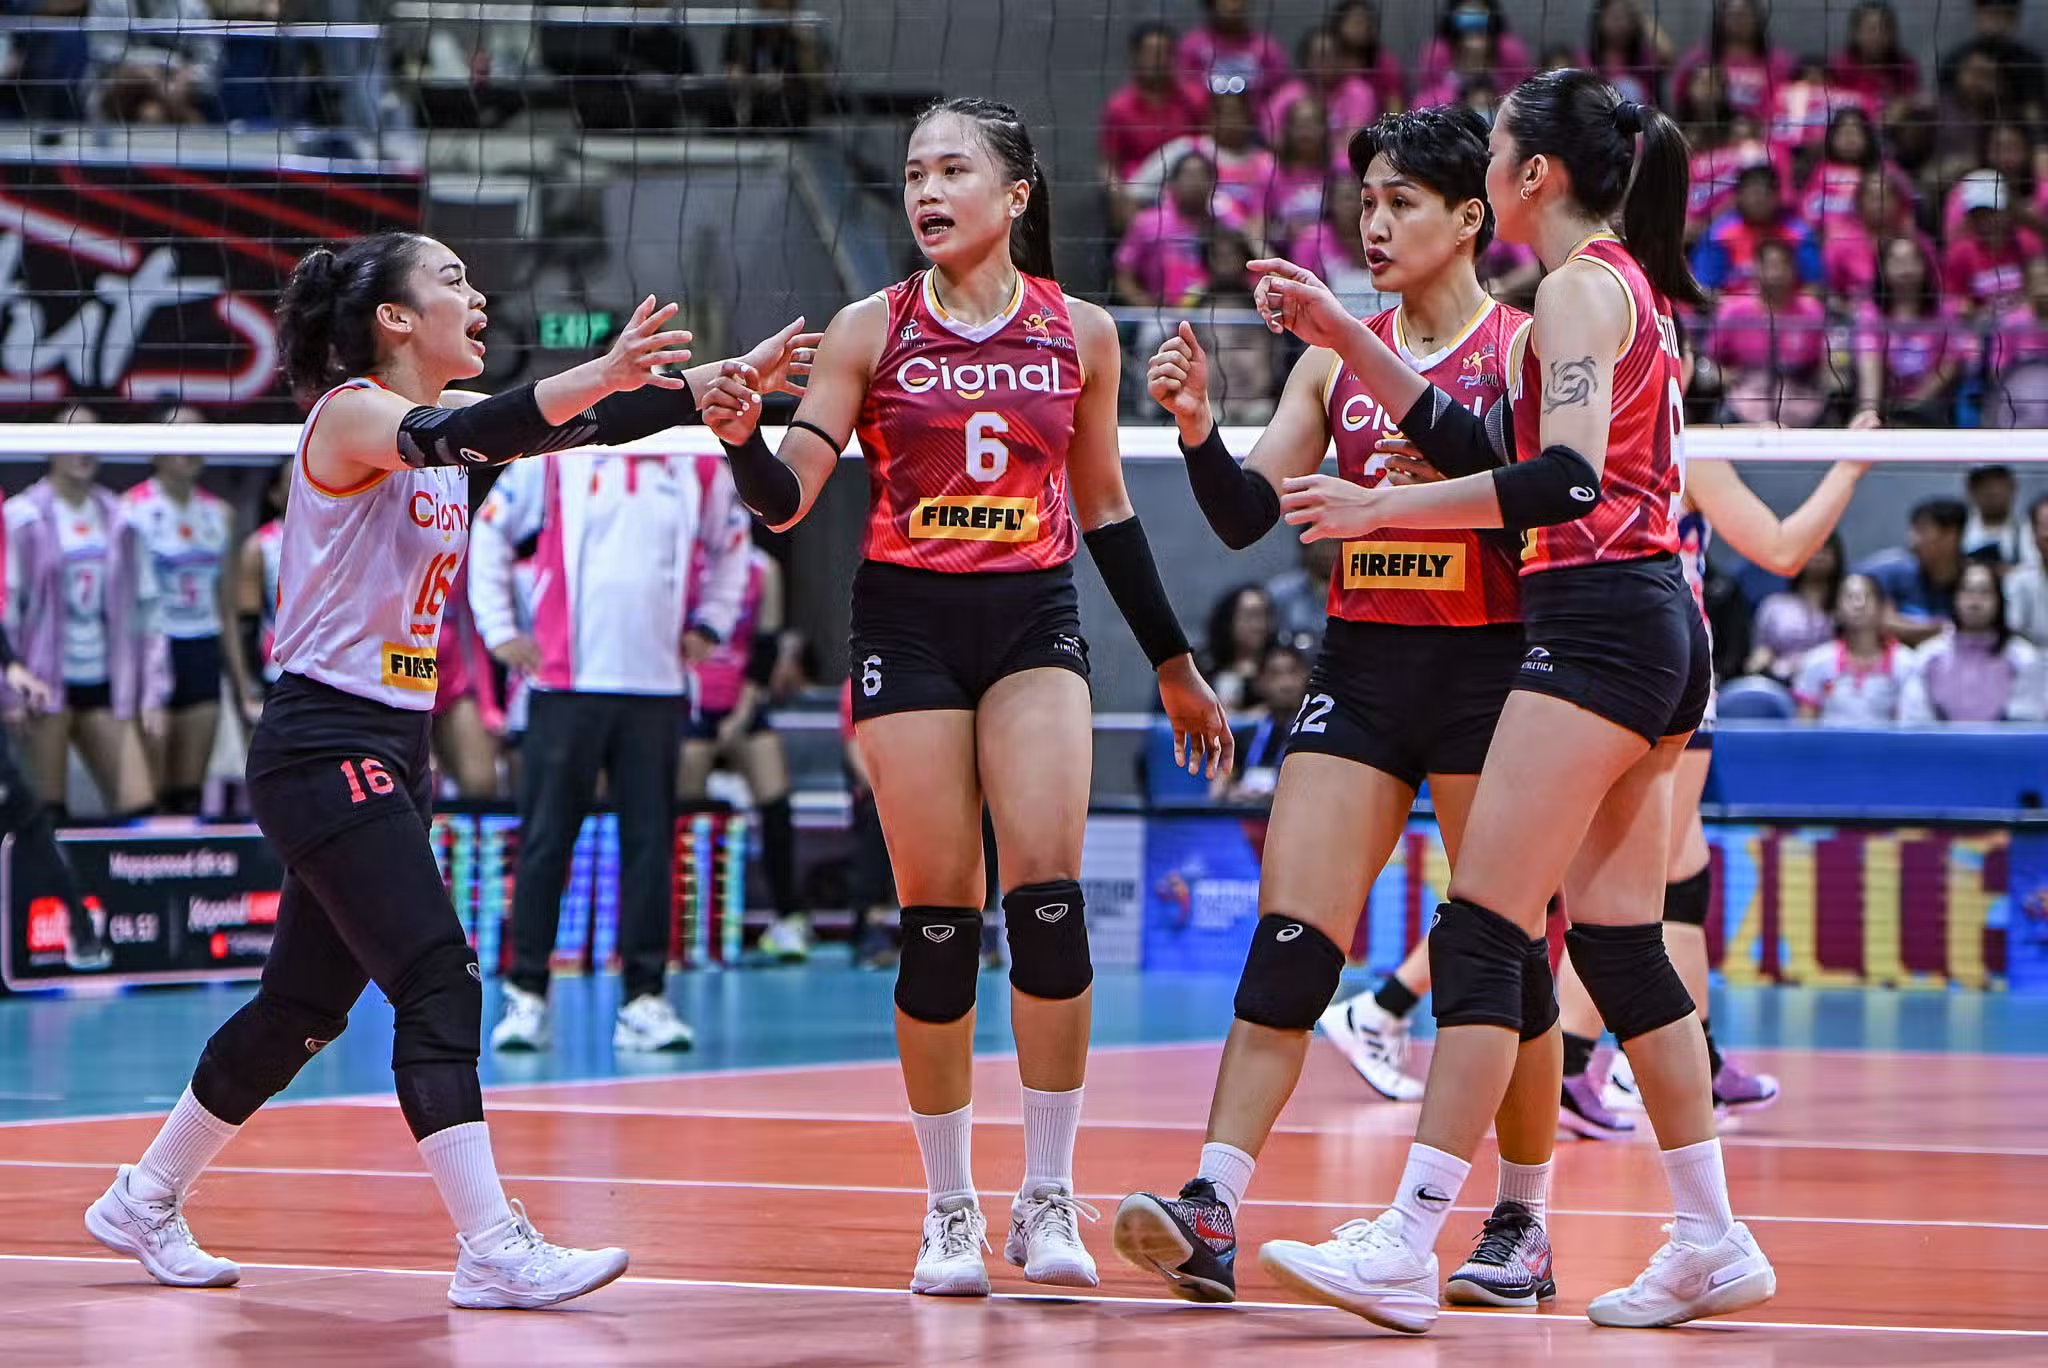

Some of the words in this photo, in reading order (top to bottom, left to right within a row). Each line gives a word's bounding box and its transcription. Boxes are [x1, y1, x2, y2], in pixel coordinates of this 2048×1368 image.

[896, 356, 1061, 400] Cignal
[965, 411, 1009, 482] 6
[921, 505, 1025, 531] FIREFLY
[413, 552, 457, 615] 16
[1351, 553, 1452, 577] FIREFLY
[391, 653, 437, 679] FIREF
[862, 655, 883, 697] 6
[340, 758, 395, 803] 16
